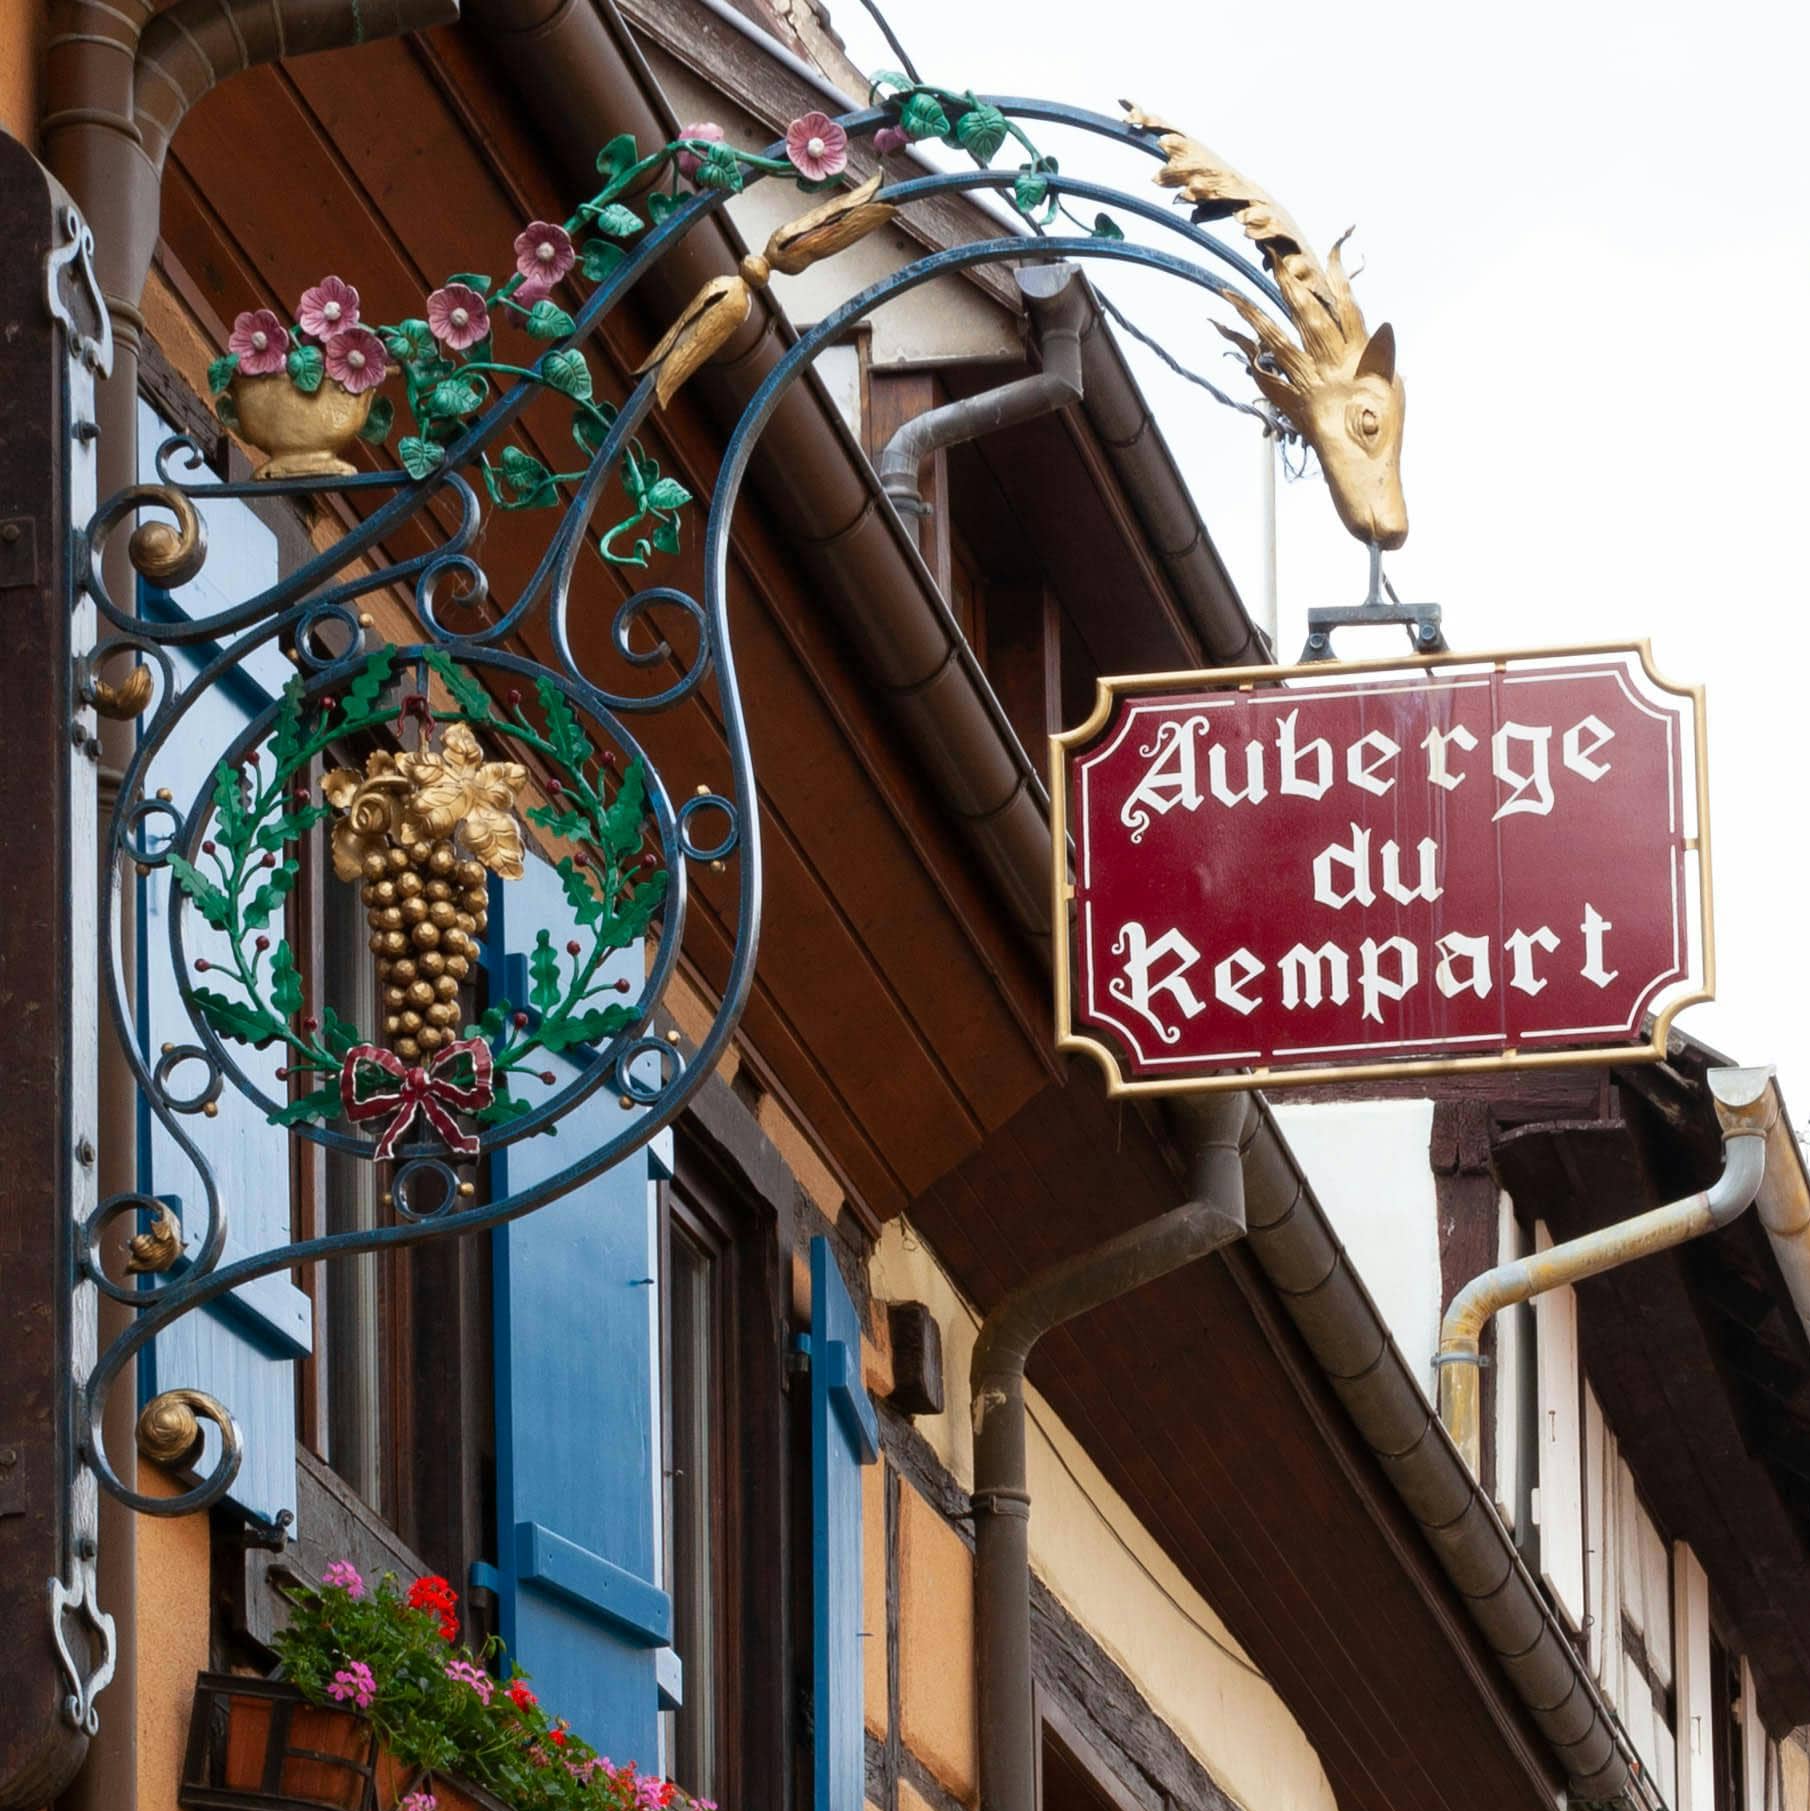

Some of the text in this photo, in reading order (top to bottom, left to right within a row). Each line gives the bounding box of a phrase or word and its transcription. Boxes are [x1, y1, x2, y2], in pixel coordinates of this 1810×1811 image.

[1121, 708, 1616, 844] Auberge
[1312, 821, 1444, 911] du
[1109, 903, 1619, 1045] Rempart
